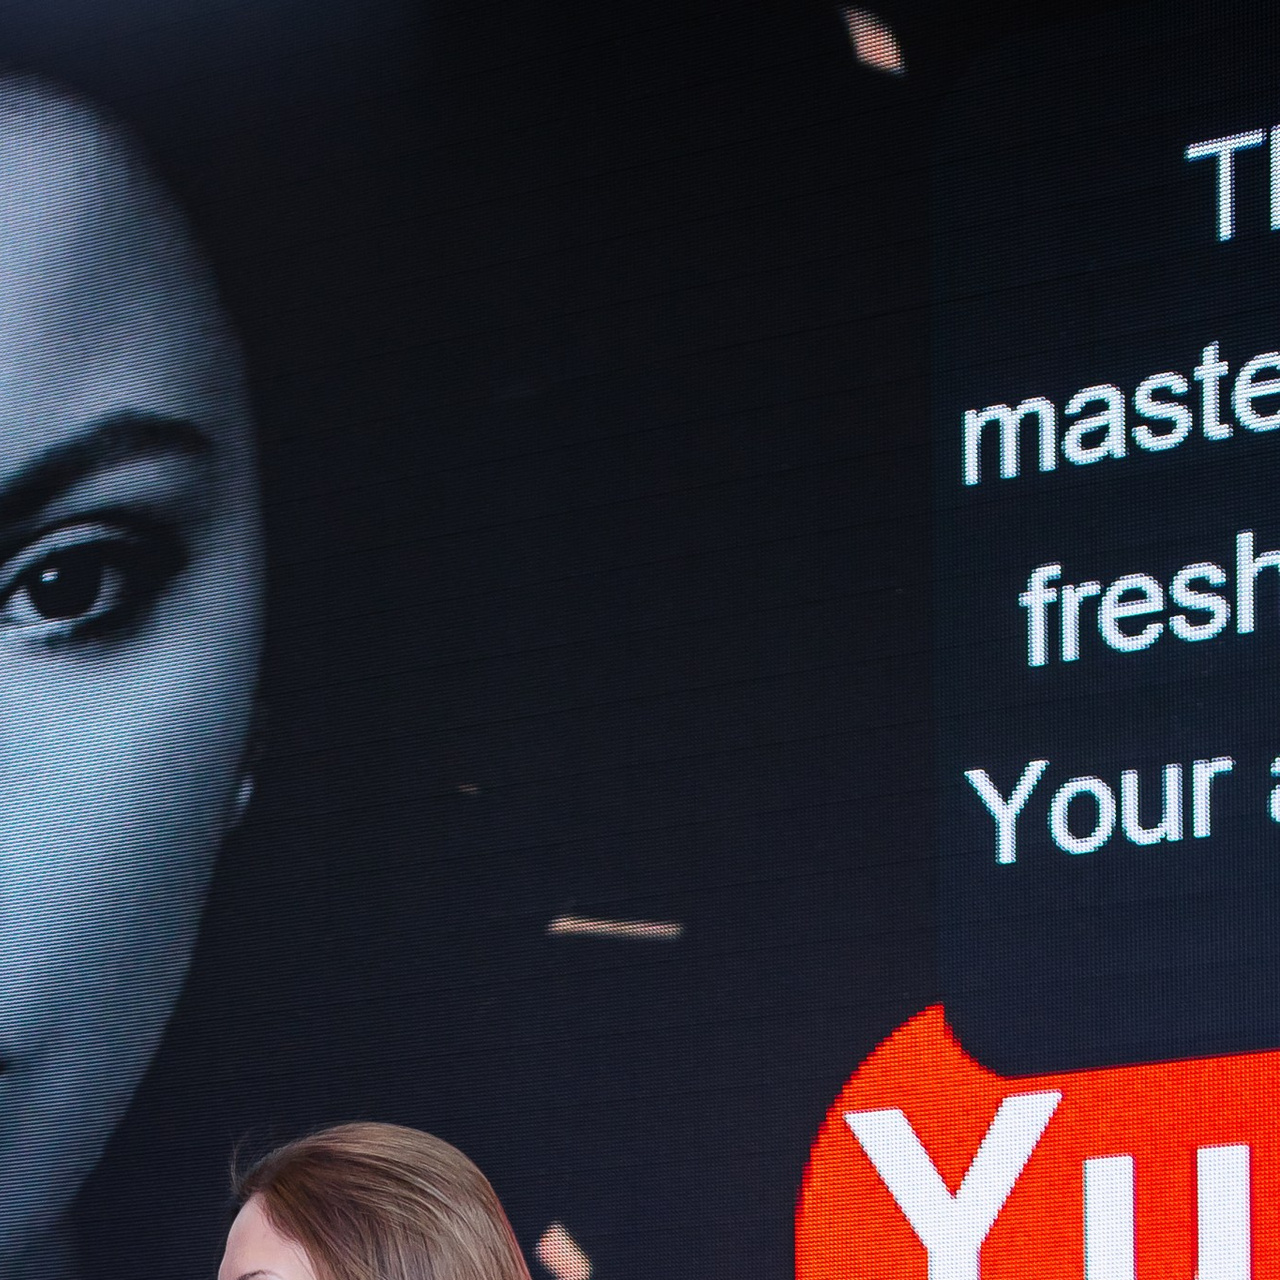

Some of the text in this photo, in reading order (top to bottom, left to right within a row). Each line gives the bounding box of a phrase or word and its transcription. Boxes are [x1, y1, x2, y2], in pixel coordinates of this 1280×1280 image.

[1185, 124, 1280, 241] T
[1018, 530, 1280, 667] fresh
[964, 757, 1234, 864] Your
